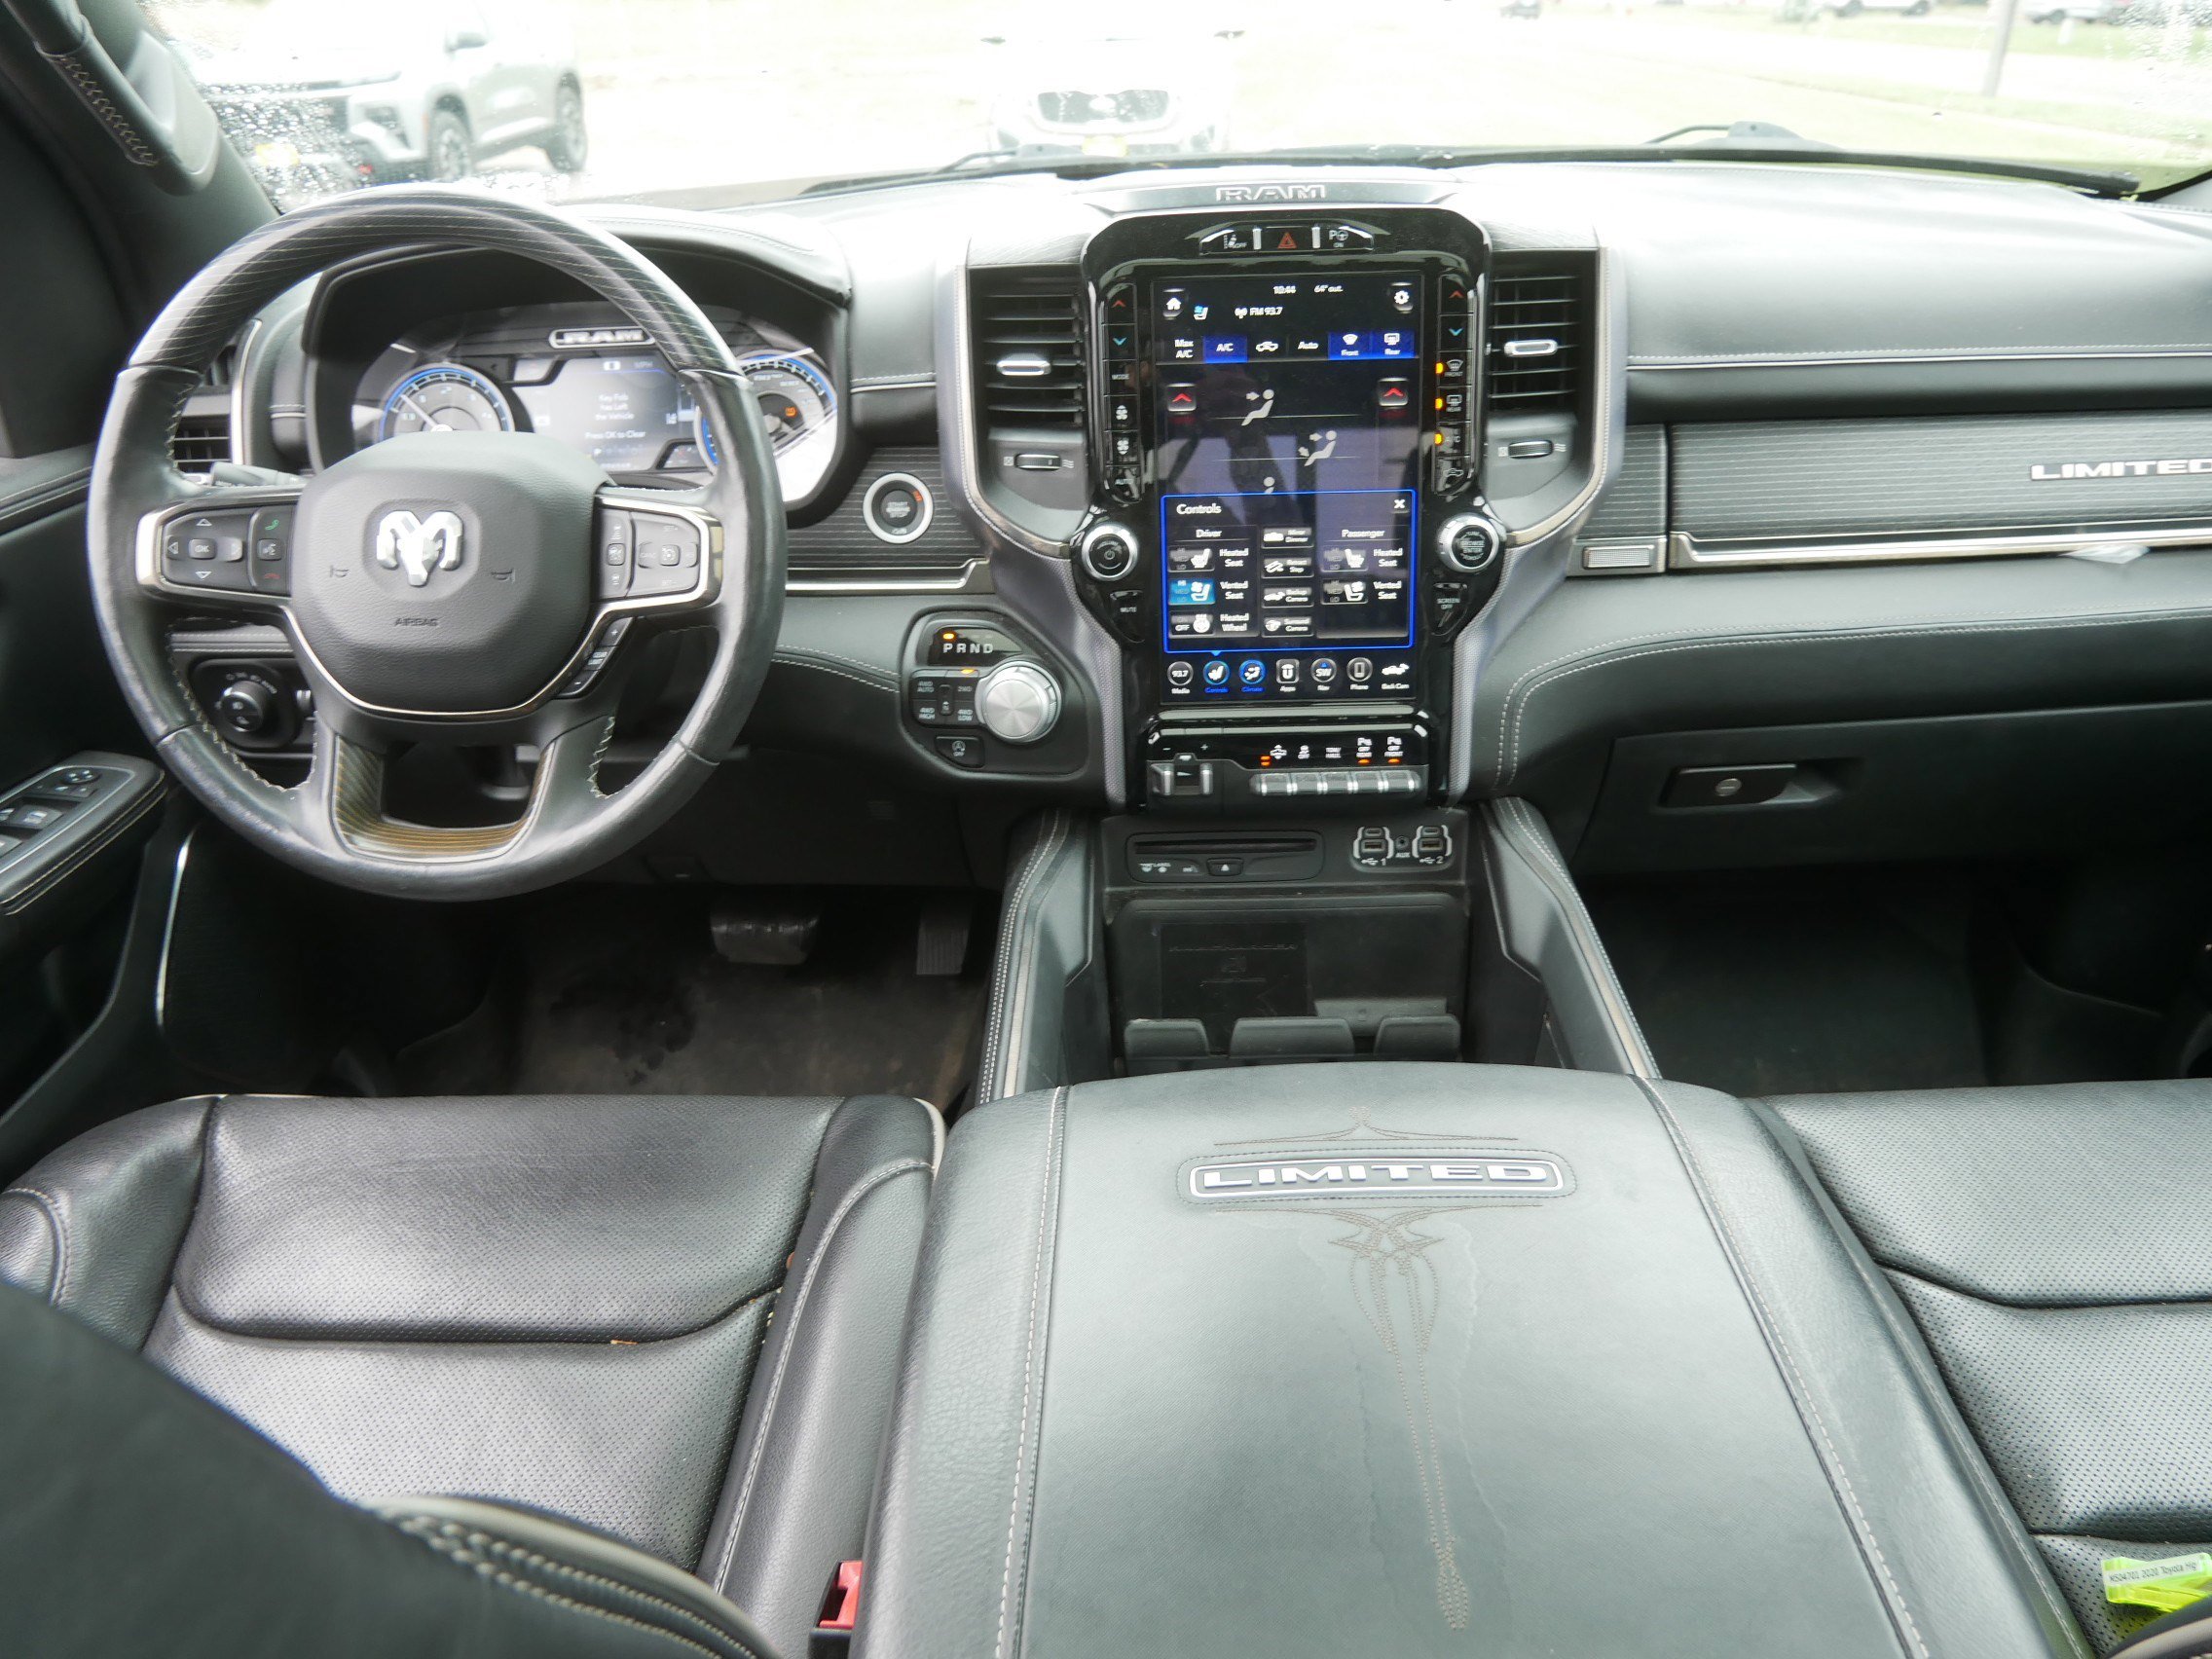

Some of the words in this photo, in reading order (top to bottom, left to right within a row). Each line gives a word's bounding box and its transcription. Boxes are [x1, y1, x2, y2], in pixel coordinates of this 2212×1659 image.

[1216, 185, 1325, 201] RAM
[1249, 307, 1264, 316] FM
[1264, 306, 1283, 316] 93.7
[561, 330, 644, 344] RAM
[1174, 339, 1195, 349] Max
[1215, 343, 1235, 352] A/C
[1297, 341, 1319, 350] Auto
[1175, 350, 1194, 359] A/C
[1176, 502, 1222, 515] Controls
[1196, 529, 1223, 538] Driver
[1341, 529, 1385, 538] Passenger
[1219, 547, 1249, 557] Heated
[1373, 547, 1403, 556] Heated
[1224, 558, 1244, 568] Seat
[1379, 558, 1398, 567] Seat
[1219, 580, 1248, 590] Vented
[1373, 580, 1403, 590] Vented
[1225, 591, 1244, 600] Seat
[1378, 591, 1398, 600] Seat
[394, 617, 439, 627] AIRBAG
[1220, 612, 1250, 622] Heated
[1221, 623, 1248, 632] Wheel
[942, 643, 953, 653] P
[956, 643, 967, 653] R
[970, 643, 980, 653] N
[983, 643, 994, 653] D
[1315, 668, 1332, 677] SW
[1203, 1163, 1549, 1189] LIMITED
